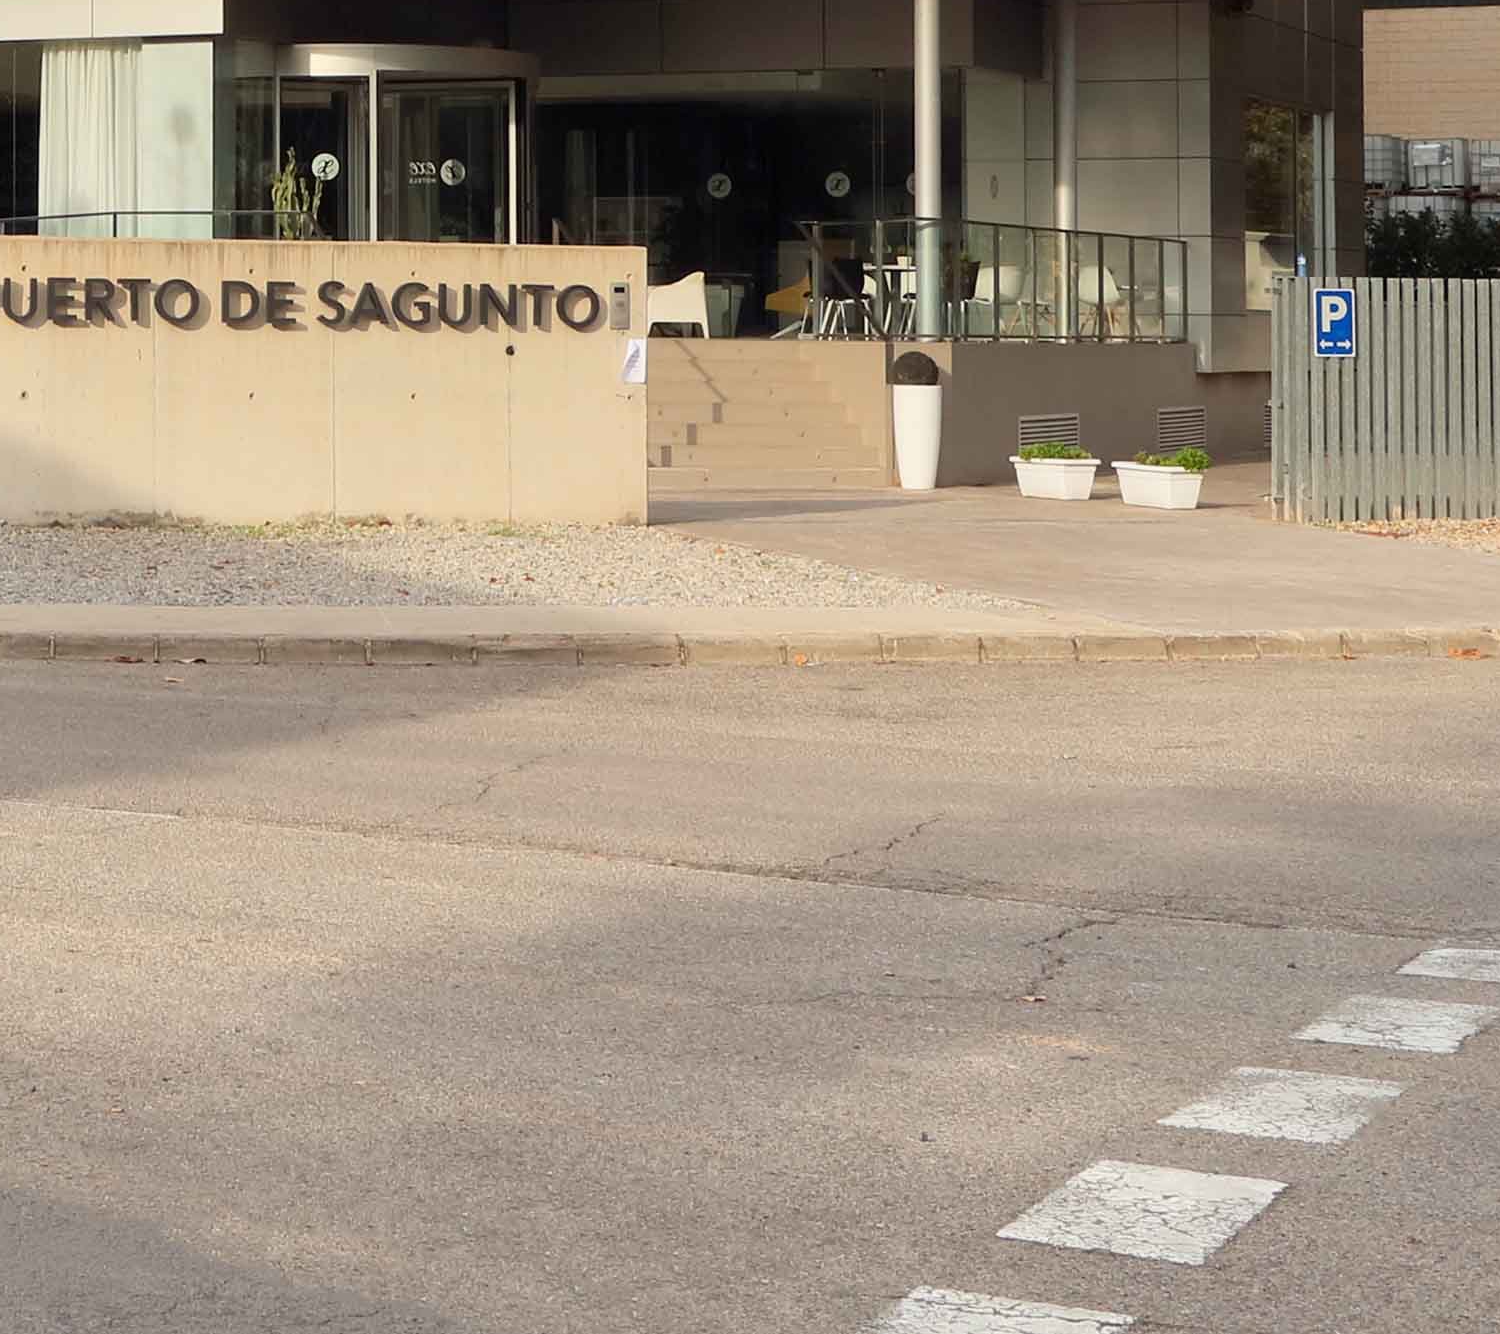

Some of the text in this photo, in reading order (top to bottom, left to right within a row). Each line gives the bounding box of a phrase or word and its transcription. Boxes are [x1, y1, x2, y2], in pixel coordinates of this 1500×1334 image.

[221, 280, 297, 326] DE
[317, 280, 600, 331] SAGUNTO
[1322, 295, 1347, 333] P
